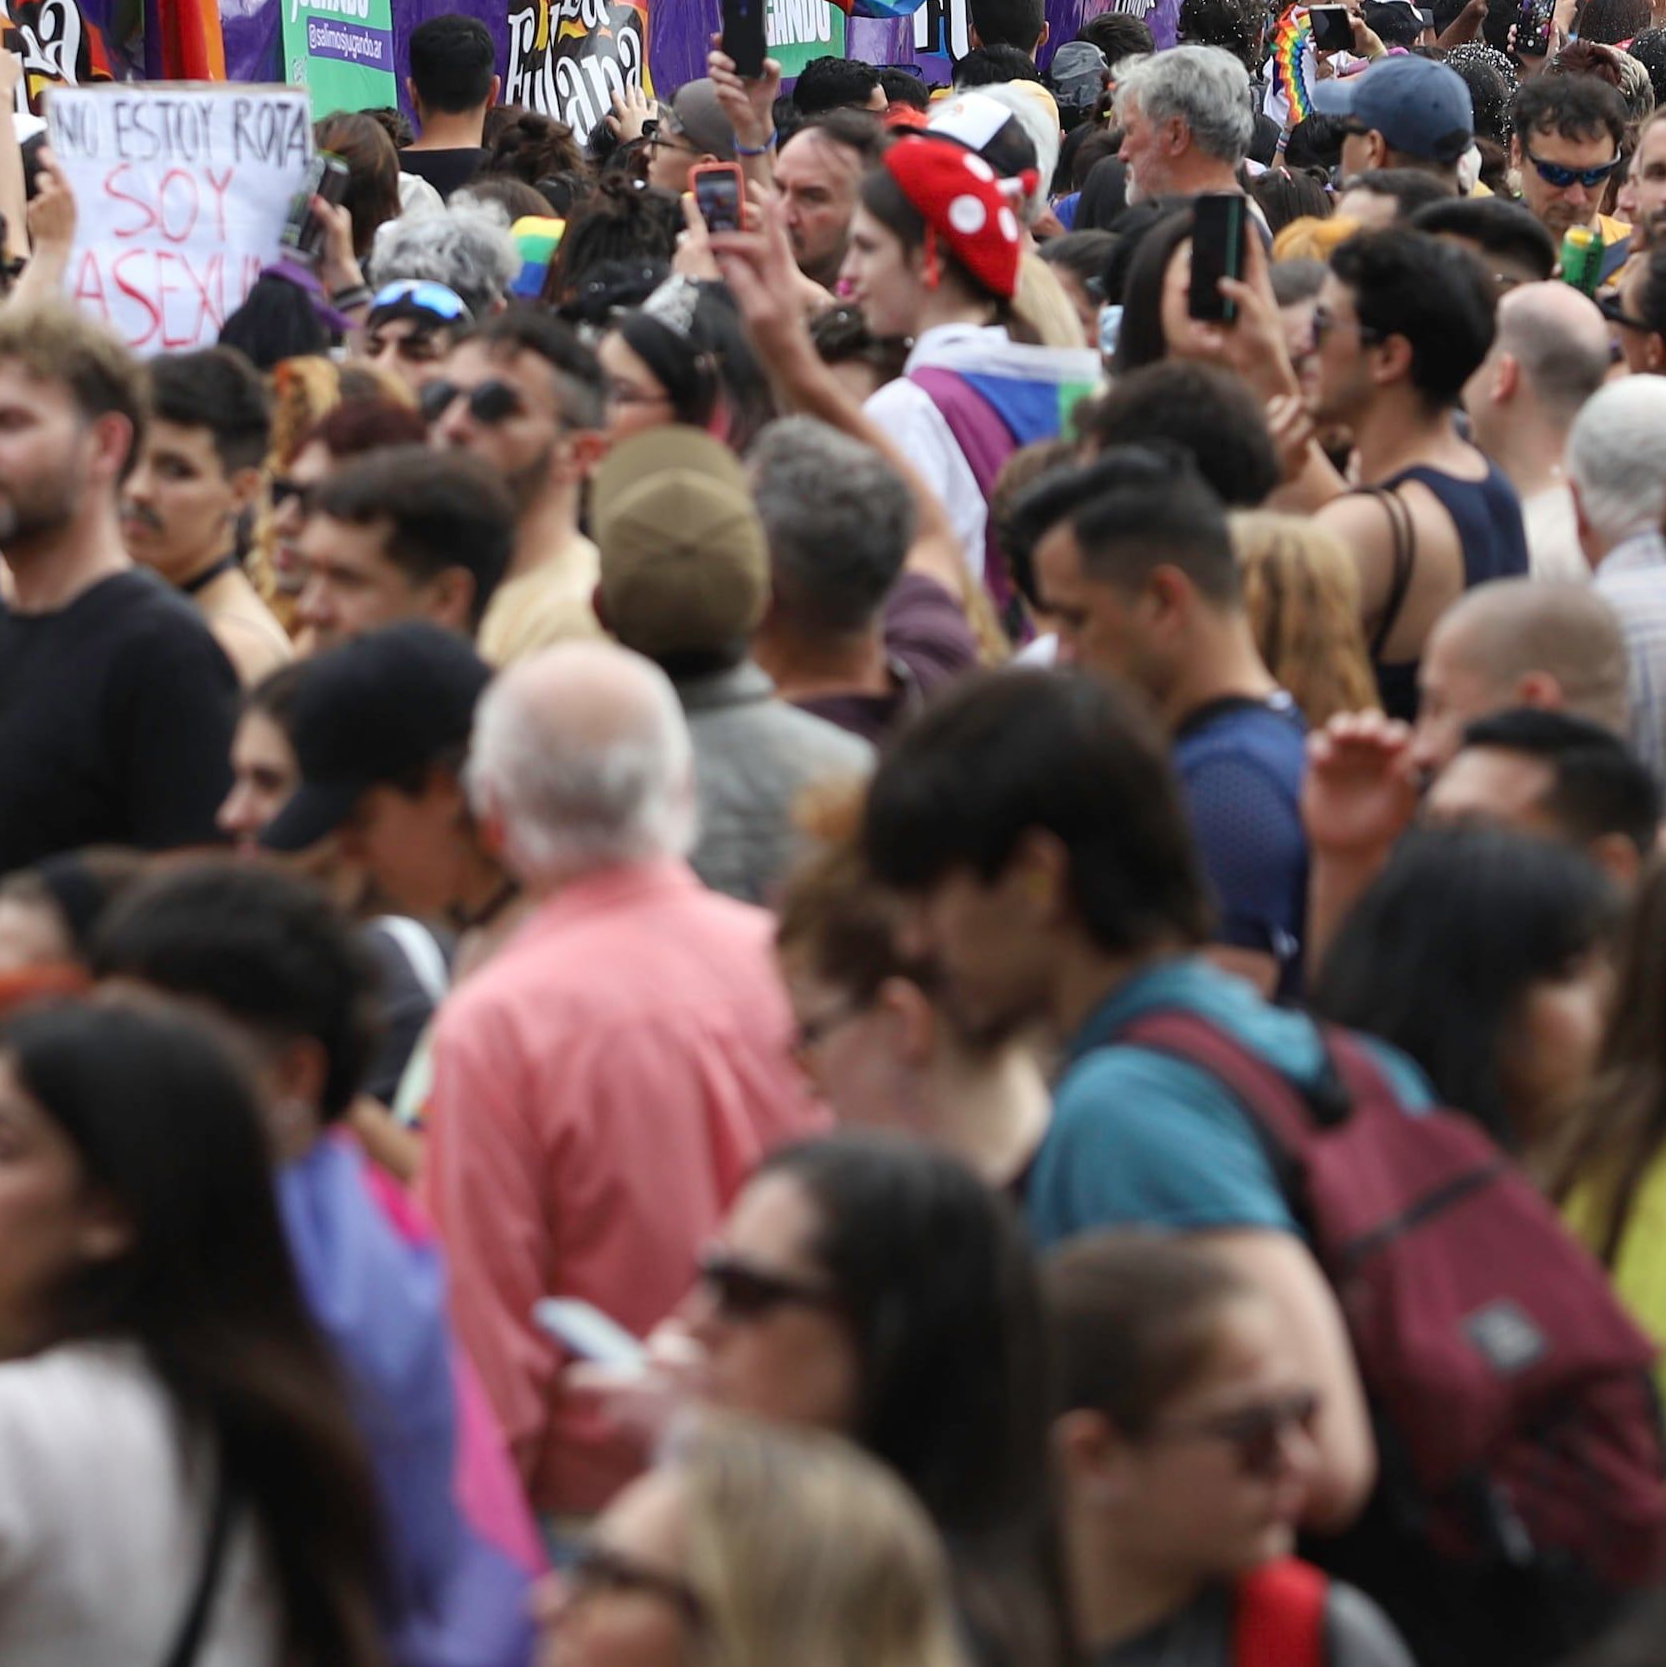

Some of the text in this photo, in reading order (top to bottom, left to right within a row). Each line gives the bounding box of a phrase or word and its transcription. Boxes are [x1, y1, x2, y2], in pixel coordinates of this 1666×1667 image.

[55, 100, 311, 167] NO ESTOY ROTA
[104, 163, 234, 243] SOY
[75, 249, 262, 350] ASEXU
